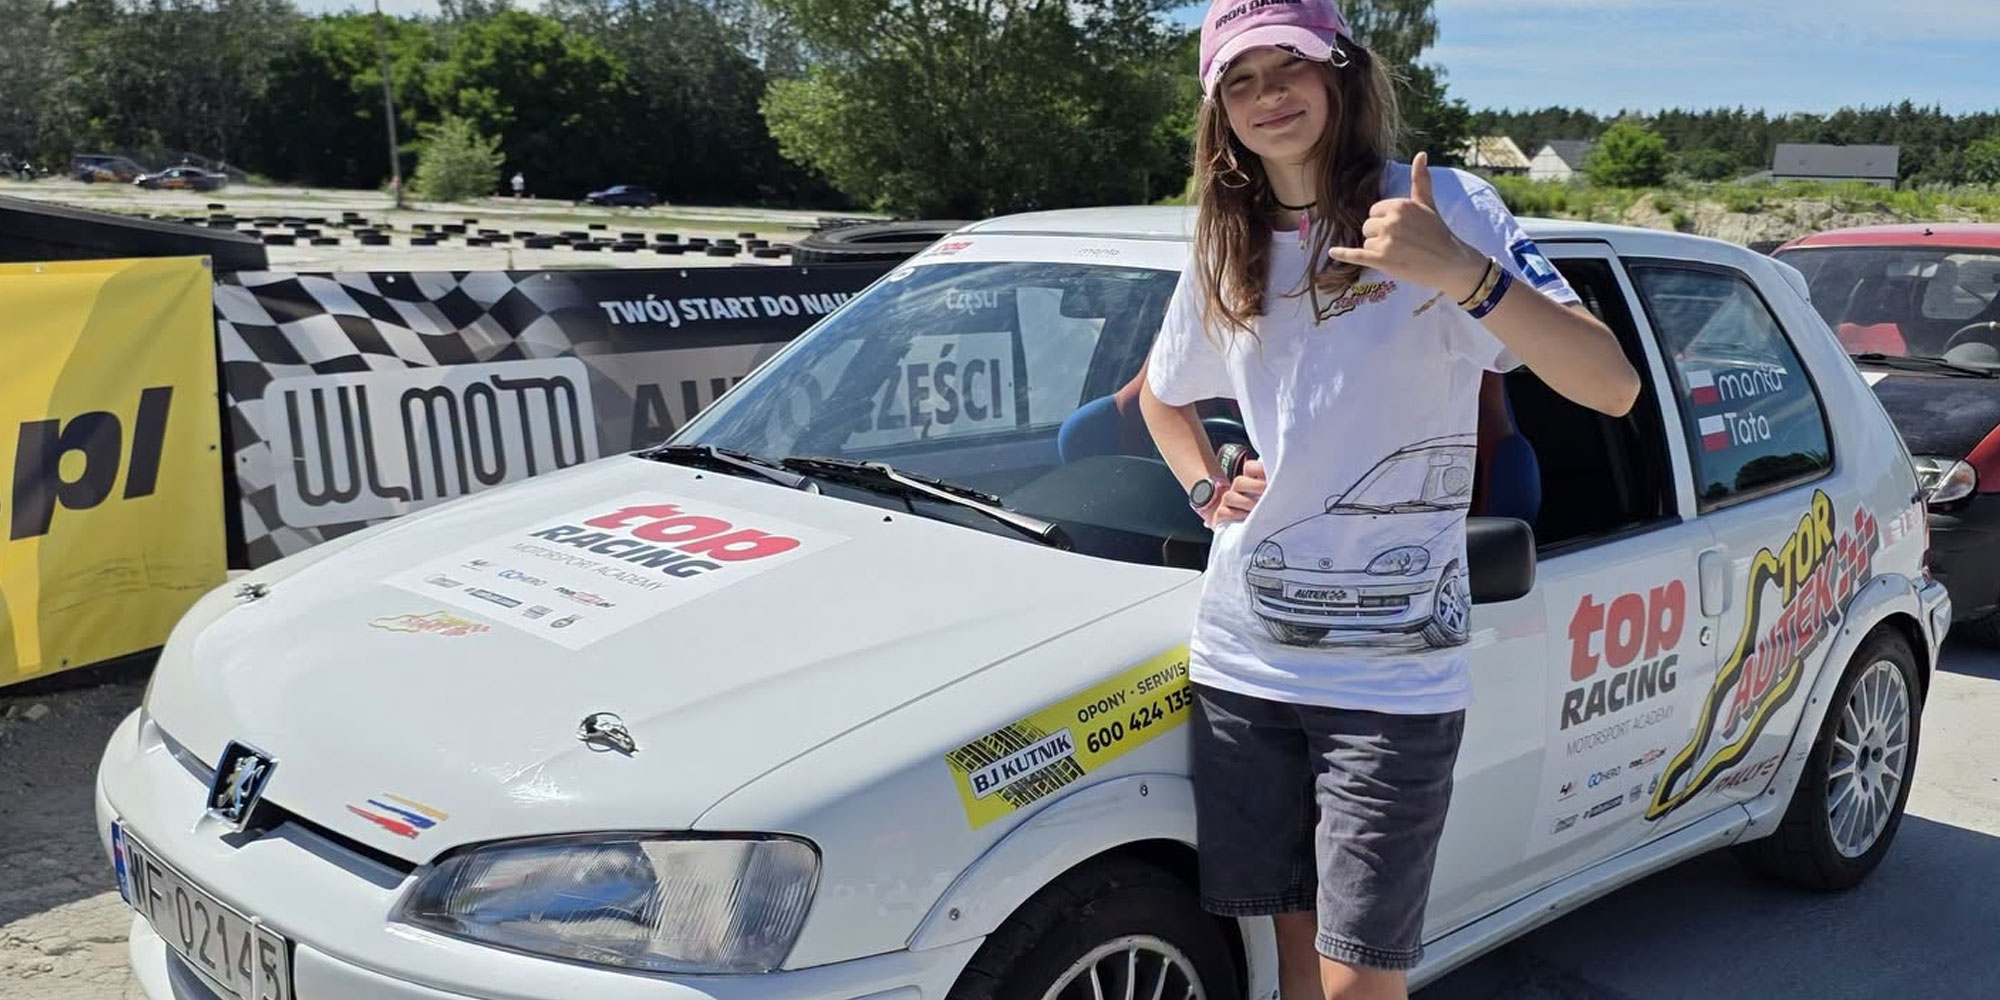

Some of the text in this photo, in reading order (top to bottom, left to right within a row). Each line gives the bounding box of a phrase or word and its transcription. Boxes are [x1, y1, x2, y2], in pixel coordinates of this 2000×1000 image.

[1215, 5, 1248, 30] IRON
[599, 294, 680, 328] TWÓJ
[680, 296, 760, 320] START
[760, 295, 800, 318] DO
[1724, 411, 1771, 446] Tata
[529, 525, 722, 578] RACING
[583, 504, 801, 562] top
[1779, 489, 1835, 607] TOR
[511, 542, 597, 569] MOTORSPORT
[597, 562, 672, 591] ACADEMY
[1568, 579, 1686, 682] top
[1722, 547, 1841, 738] AUTEK
[1077, 689, 1127, 724] OPONY
[1136, 661, 1187, 696] SERWIS
[1086, 685, 1193, 754] 600 424 135
[1560, 655, 1679, 731] RACING
[1566, 704, 1675, 757] MOTORSPORT ACADEMY
[973, 734, 1072, 794] BJ KUTNIK
[128, 845, 163, 922] WF
